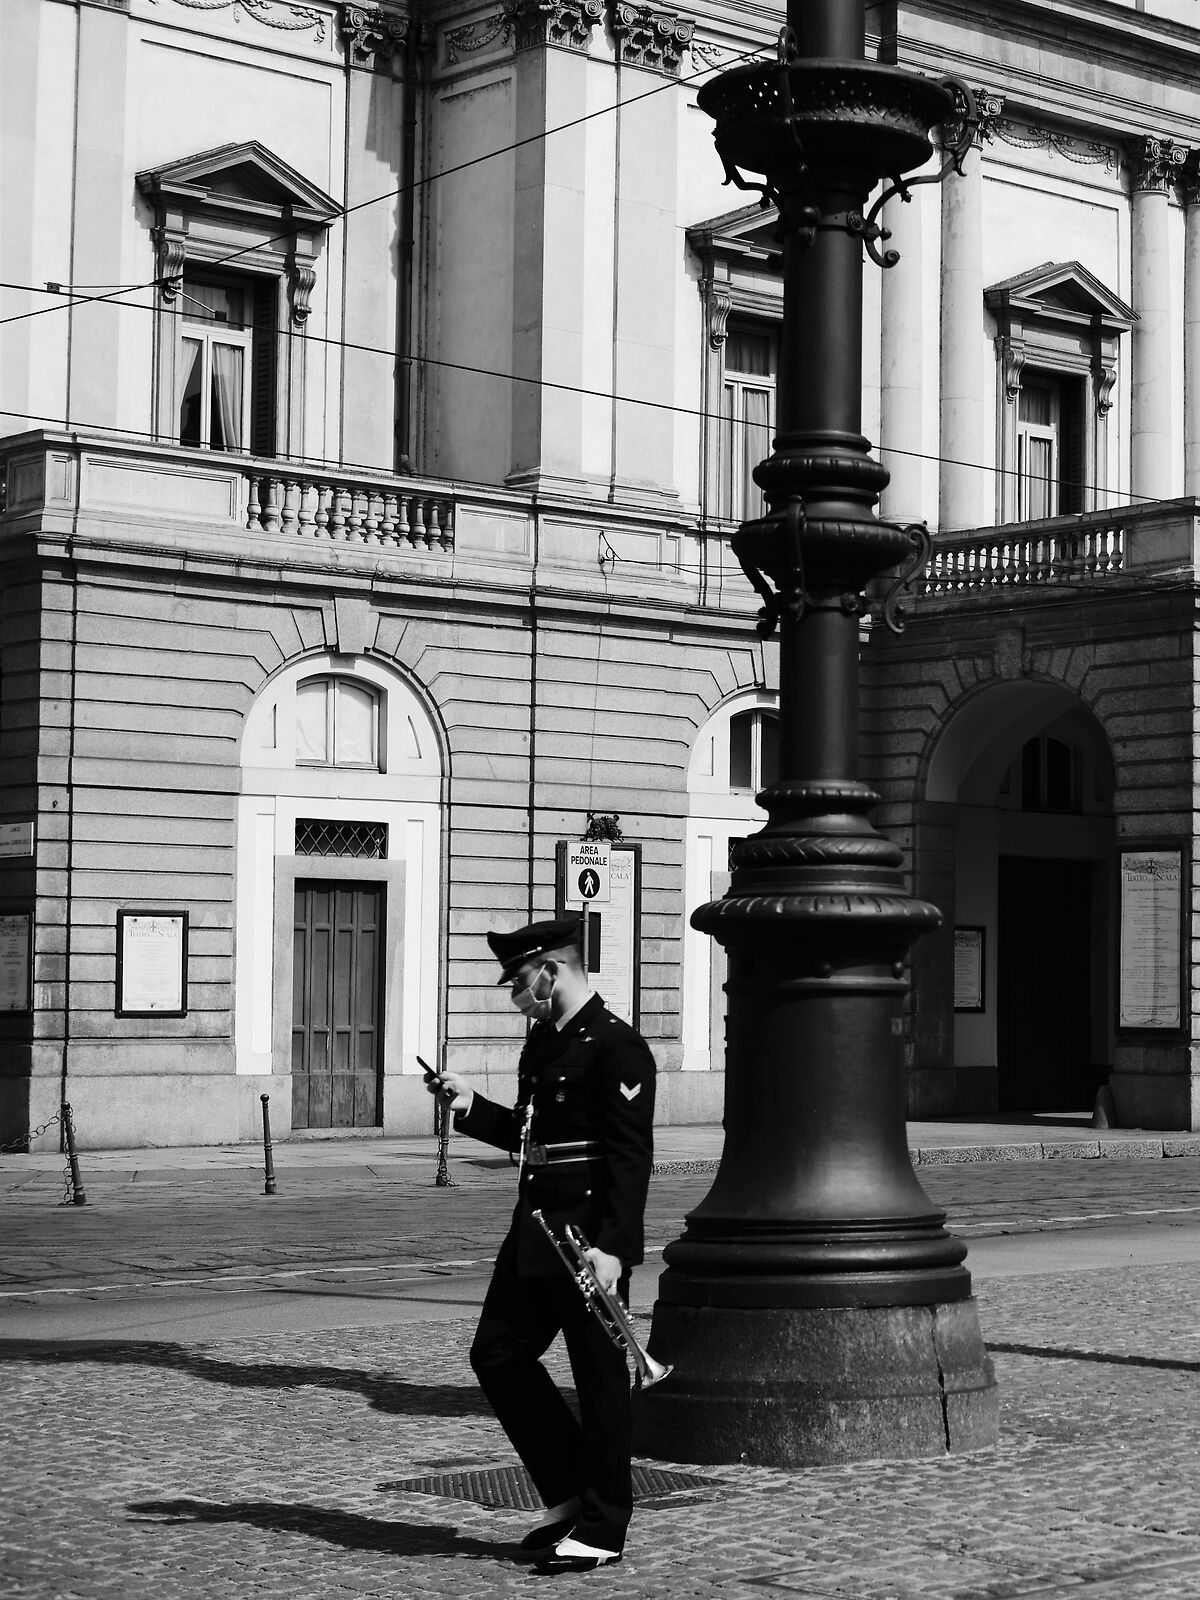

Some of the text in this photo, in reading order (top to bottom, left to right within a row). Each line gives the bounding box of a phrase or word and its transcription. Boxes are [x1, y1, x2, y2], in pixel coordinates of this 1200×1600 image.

[580, 845, 599, 855] AREA
[571, 855, 608, 866] PEDONALE
[610, 872, 630, 880] CALA
